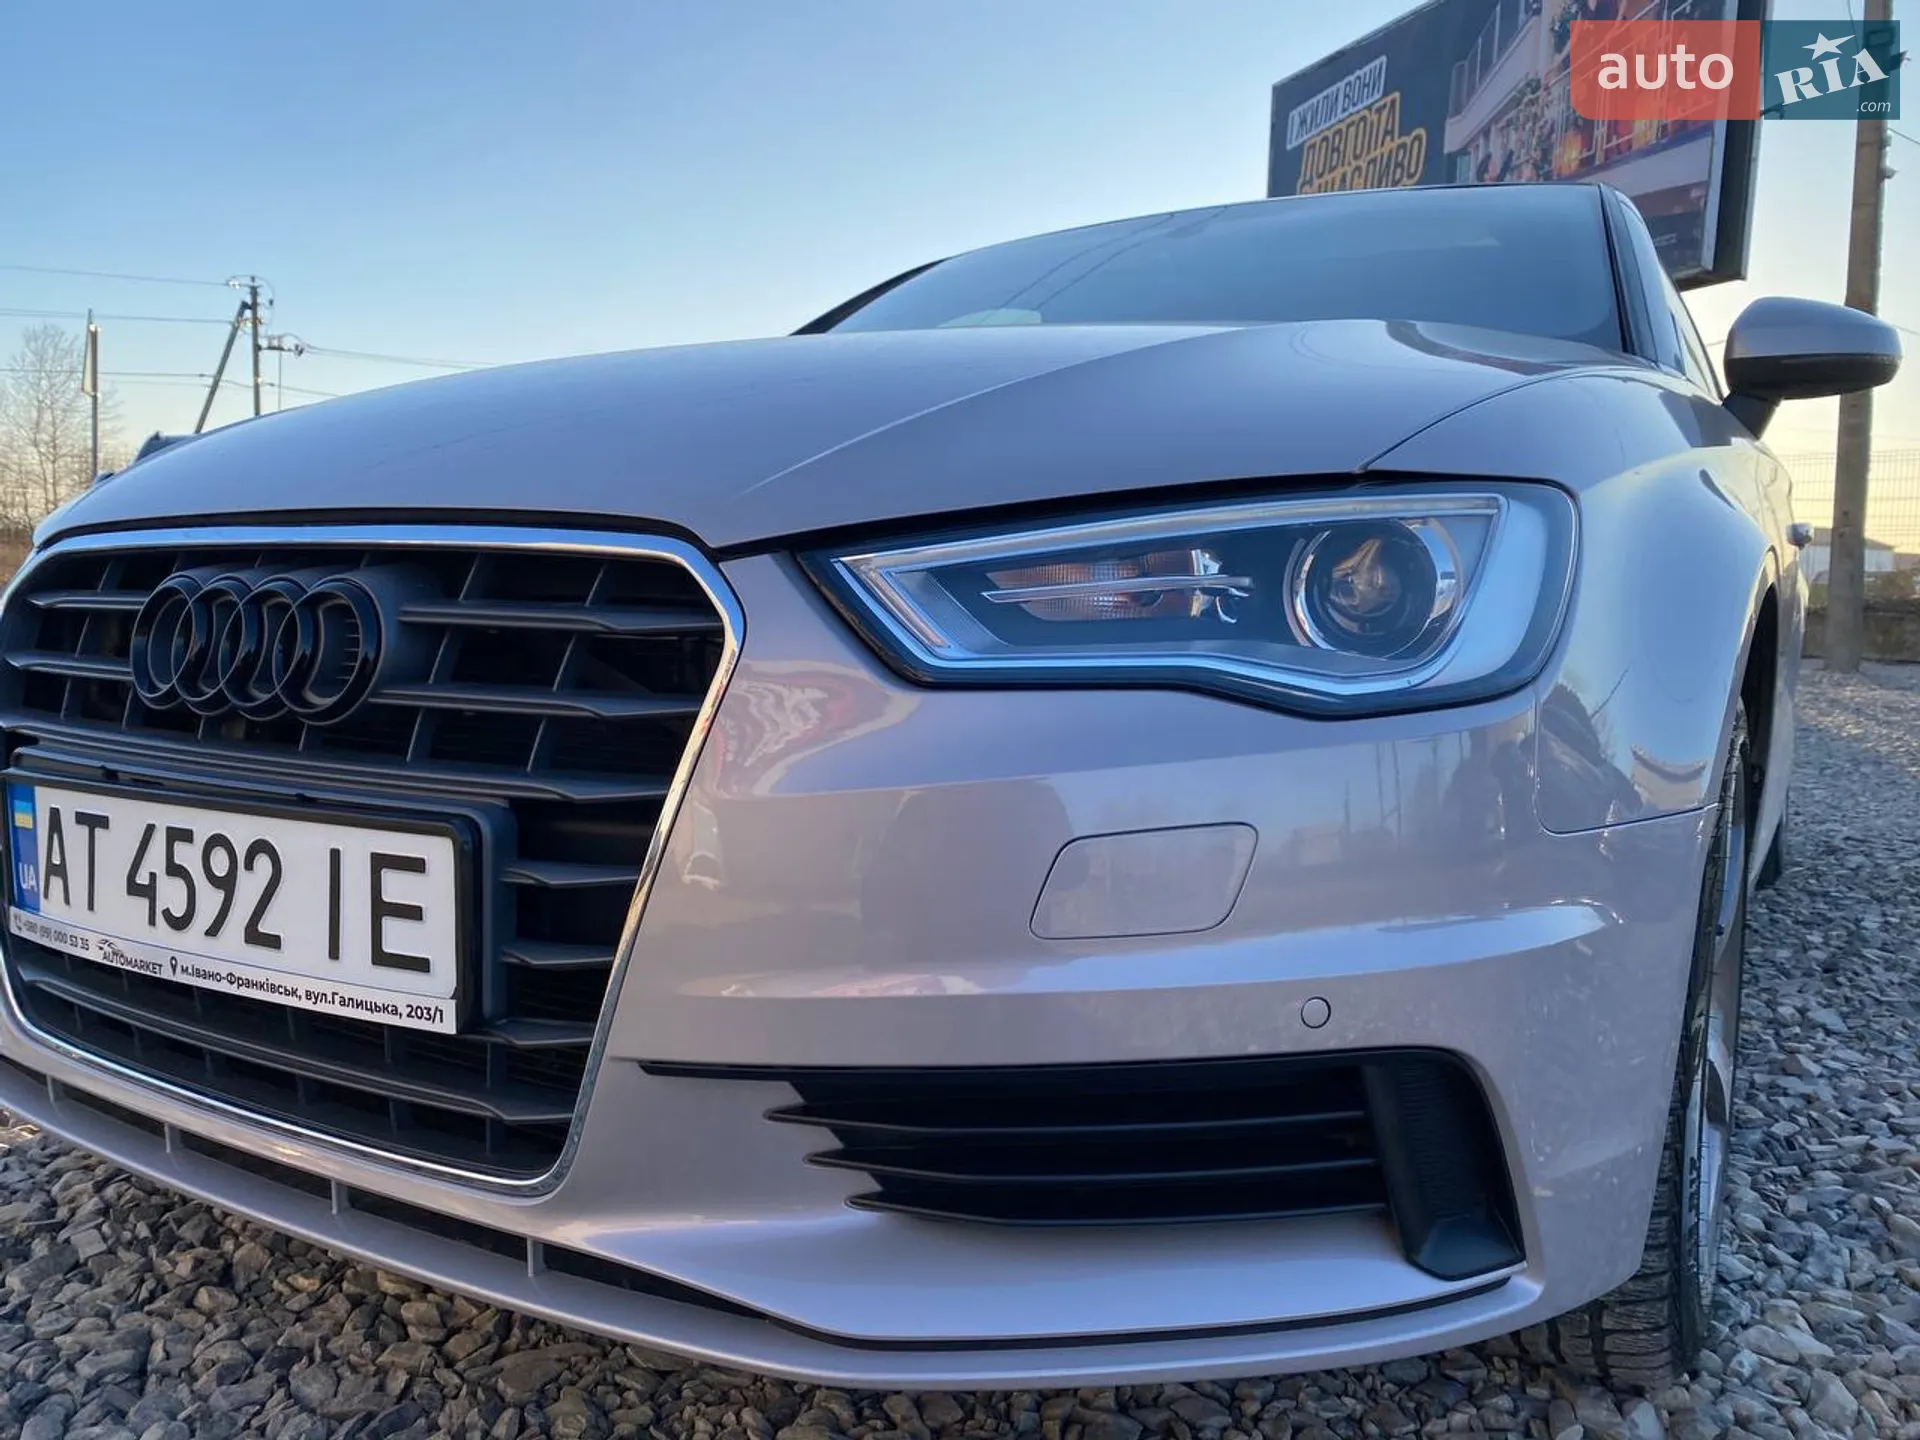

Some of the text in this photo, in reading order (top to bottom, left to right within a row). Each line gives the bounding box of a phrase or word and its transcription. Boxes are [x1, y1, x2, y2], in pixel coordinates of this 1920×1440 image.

[1296, 86, 1340, 138] ЖИЛИ
[1341, 62, 1383, 114] ВОНИ
[1317, 132, 1424, 192] СЛИВО
[18, 862, 38, 892] UA
[43, 806, 431, 974] AT 4592 IE
[102, 950, 164, 976] AUTOMARKET
[304, 990, 403, 1020] вул.Галицька,
[405, 1003, 445, 1025] 203/1
